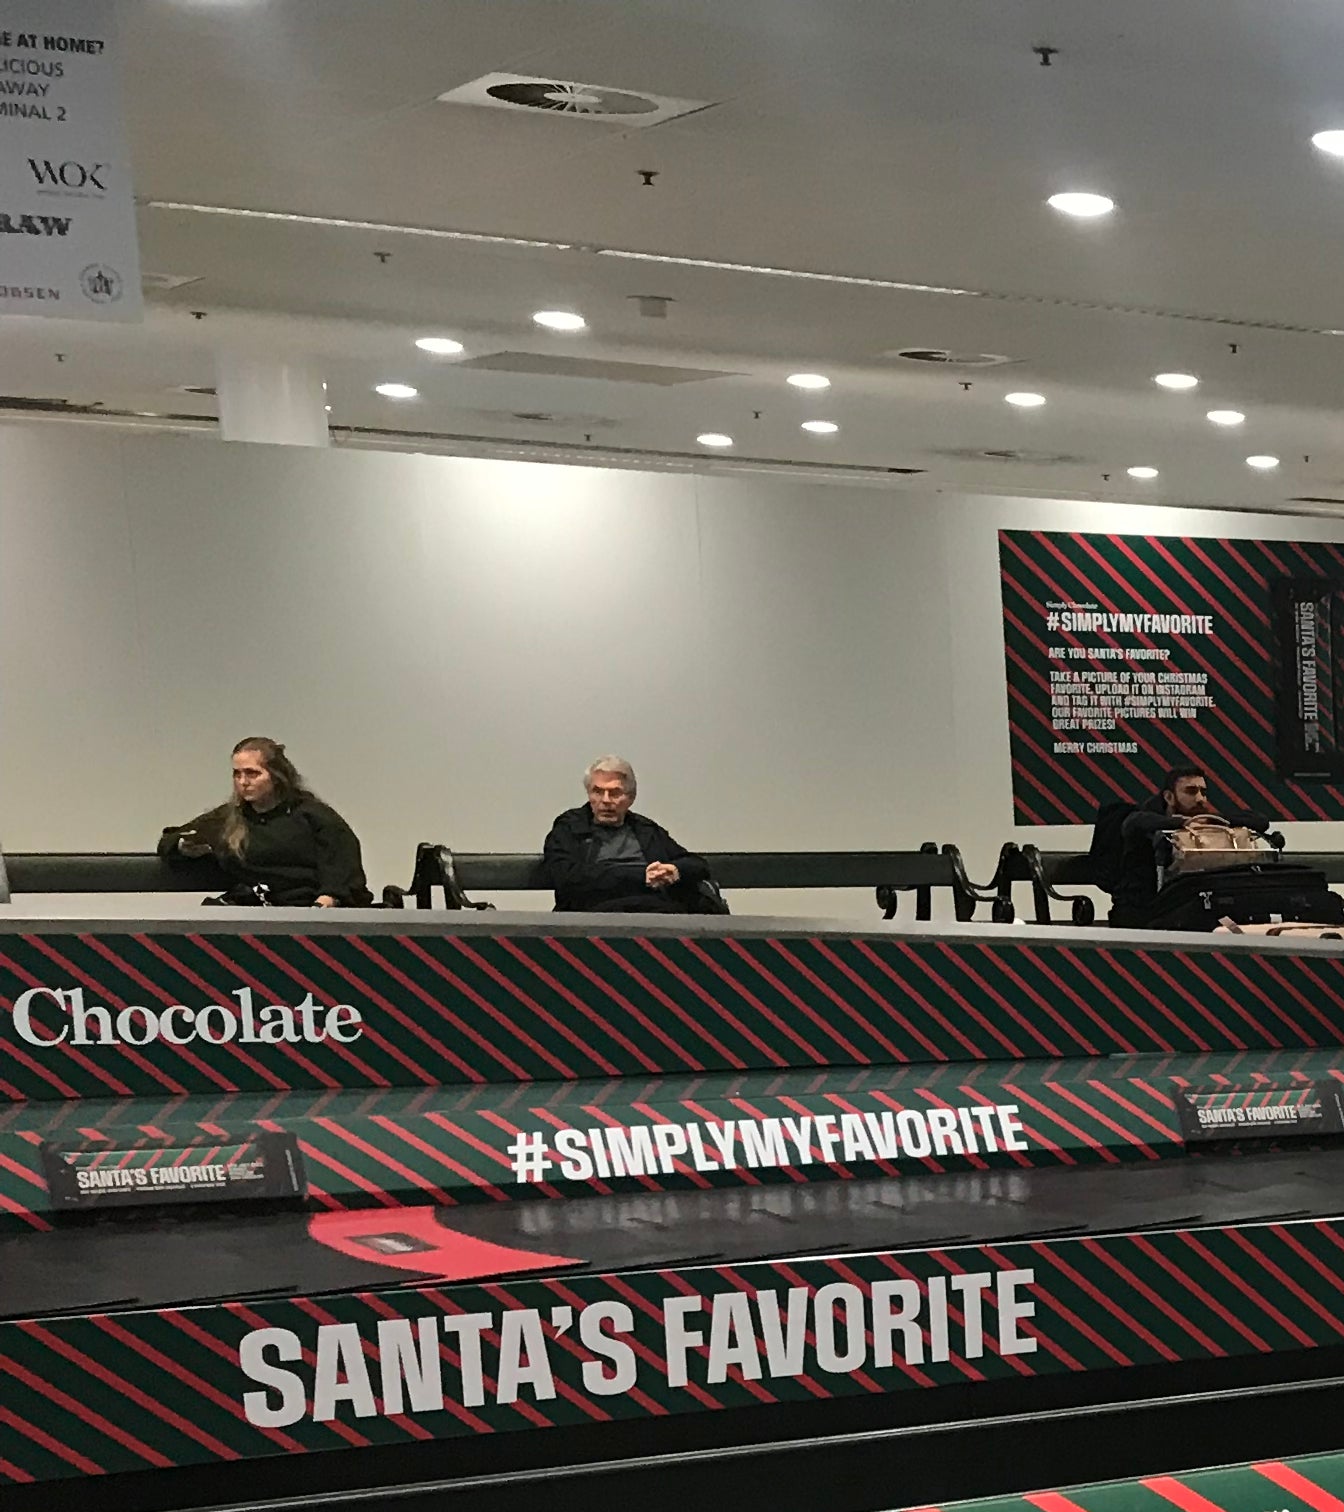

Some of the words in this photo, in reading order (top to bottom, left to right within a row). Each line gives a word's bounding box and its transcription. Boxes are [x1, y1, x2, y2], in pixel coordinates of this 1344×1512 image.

[17, 33, 37, 49] AT
[44, 36, 104, 54] HOME?
[57, 106, 66, 121] 2
[1047, 612, 1213, 634] #SIMPLYMYFAVORITE
[1300, 602, 1316, 657] SANTA'S
[1049, 648, 1065, 659] ARE
[1068, 648, 1086, 659] YOU
[1126, 649, 1170, 660] FAVORITE?
[1050, 671, 1071, 682] TAKE
[1082, 672, 1118, 683] PICTURE
[1158, 673, 1208, 684] CHRISTMAS
[1302, 660, 1318, 721] FAVORITE
[1087, 743, 1138, 754] CHRISTMAS
[12, 987, 363, 1046] Chocolate
[1197, 1107, 1245, 1124] SANTA'S
[1246, 1105, 1297, 1121] FAVORITE
[507, 1104, 1028, 1184] #SIMPLYMYFAVORITE
[77, 1167, 147, 1189] SANTA'S
[150, 1163, 226, 1186] FAVORITE
[238, 1300, 637, 1429] SANTA'S
[664, 1268, 1038, 1388] FAVORITE
